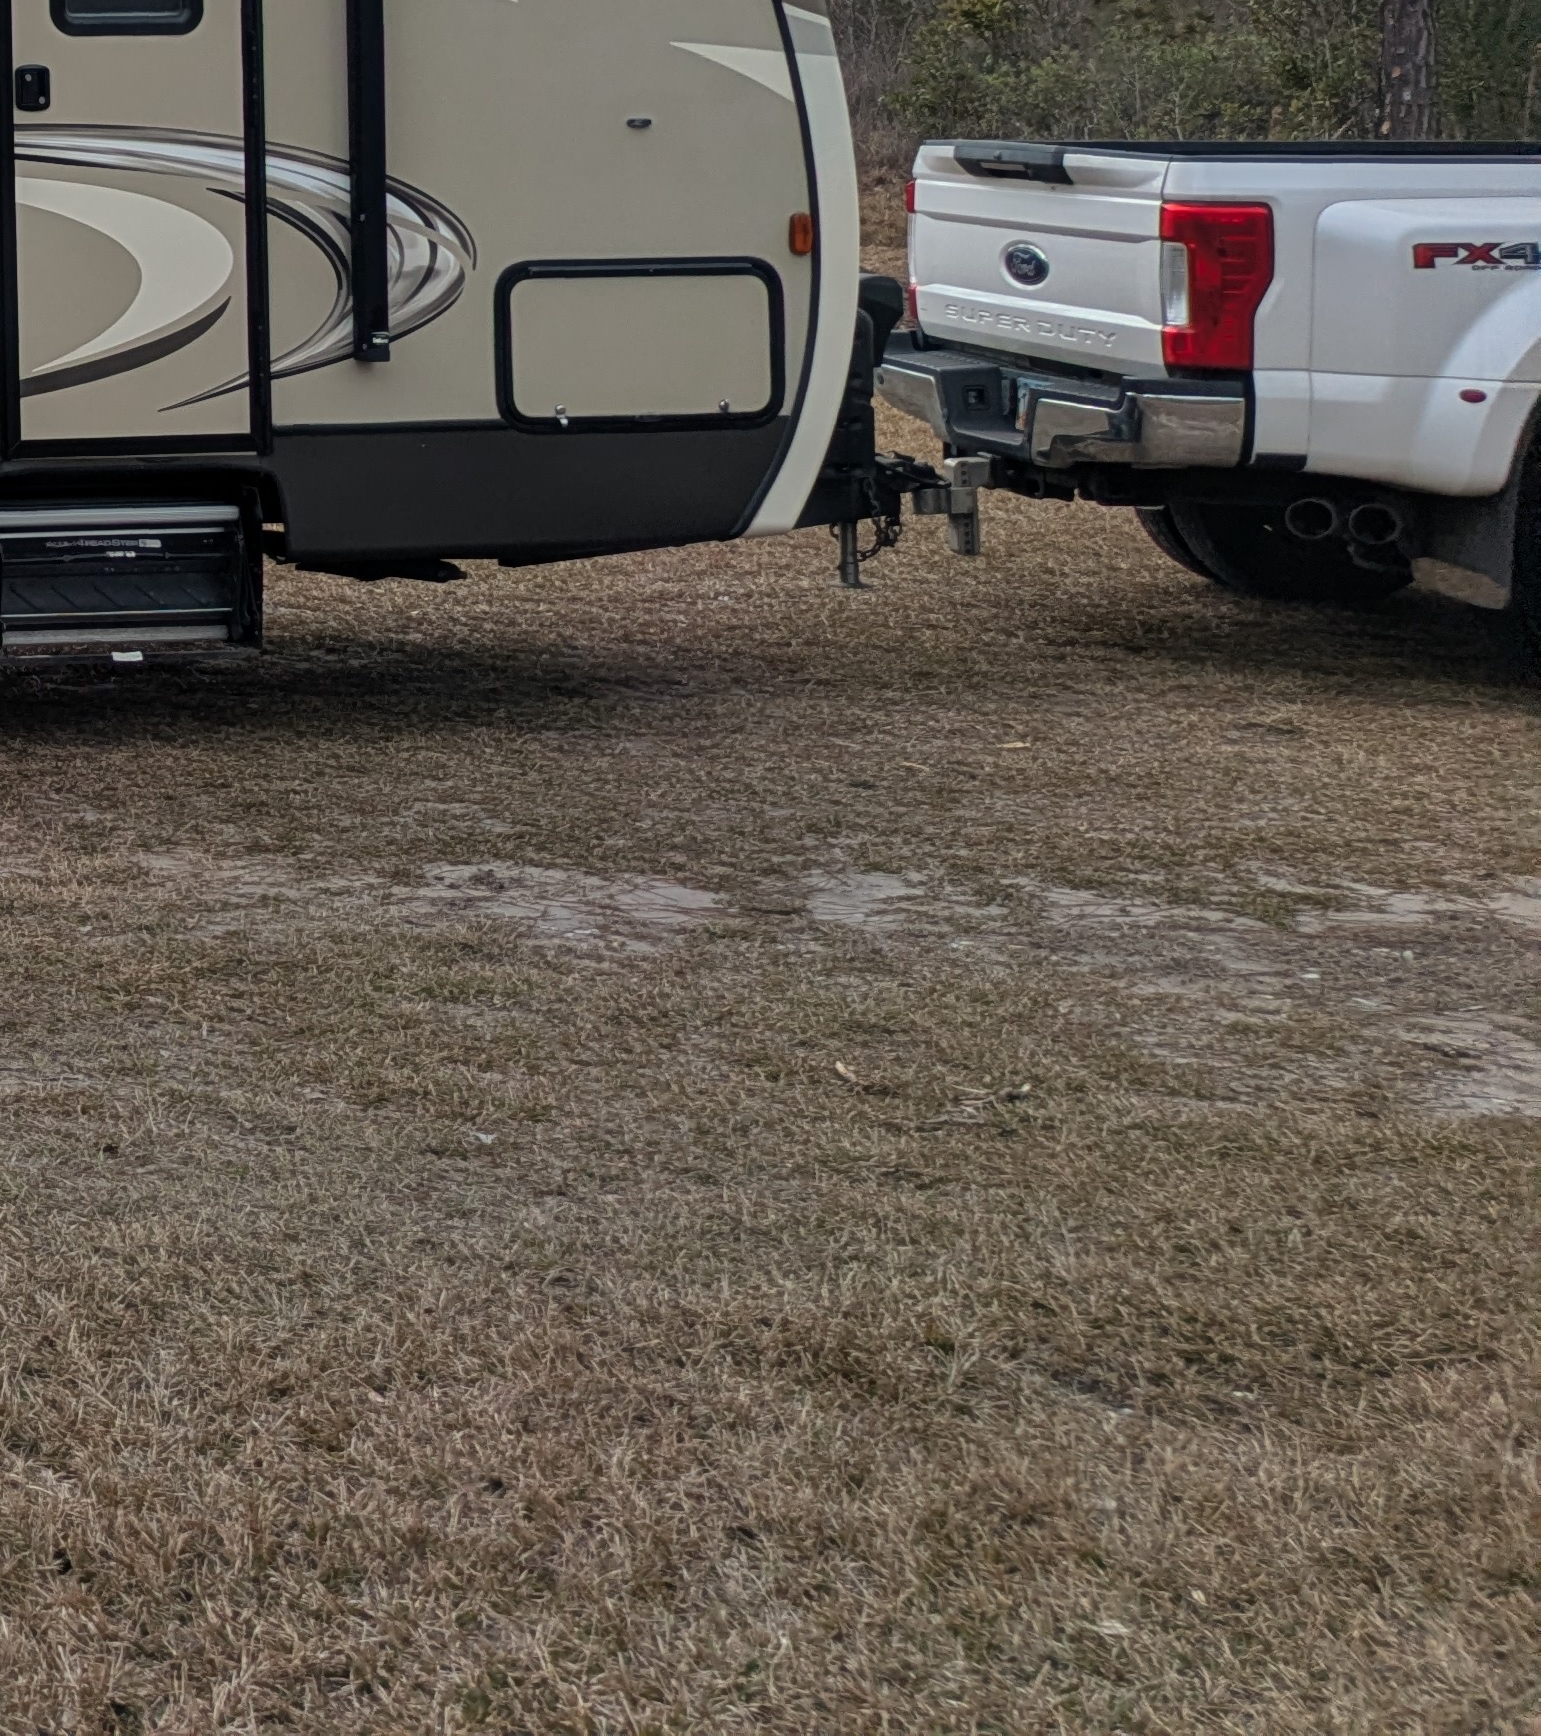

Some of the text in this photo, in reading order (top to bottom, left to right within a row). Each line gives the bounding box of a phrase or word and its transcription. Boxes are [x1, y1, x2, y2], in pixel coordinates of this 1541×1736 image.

[1412, 242, 1540, 269] FX4
[944, 303, 1117, 348] SUPER DUTY
